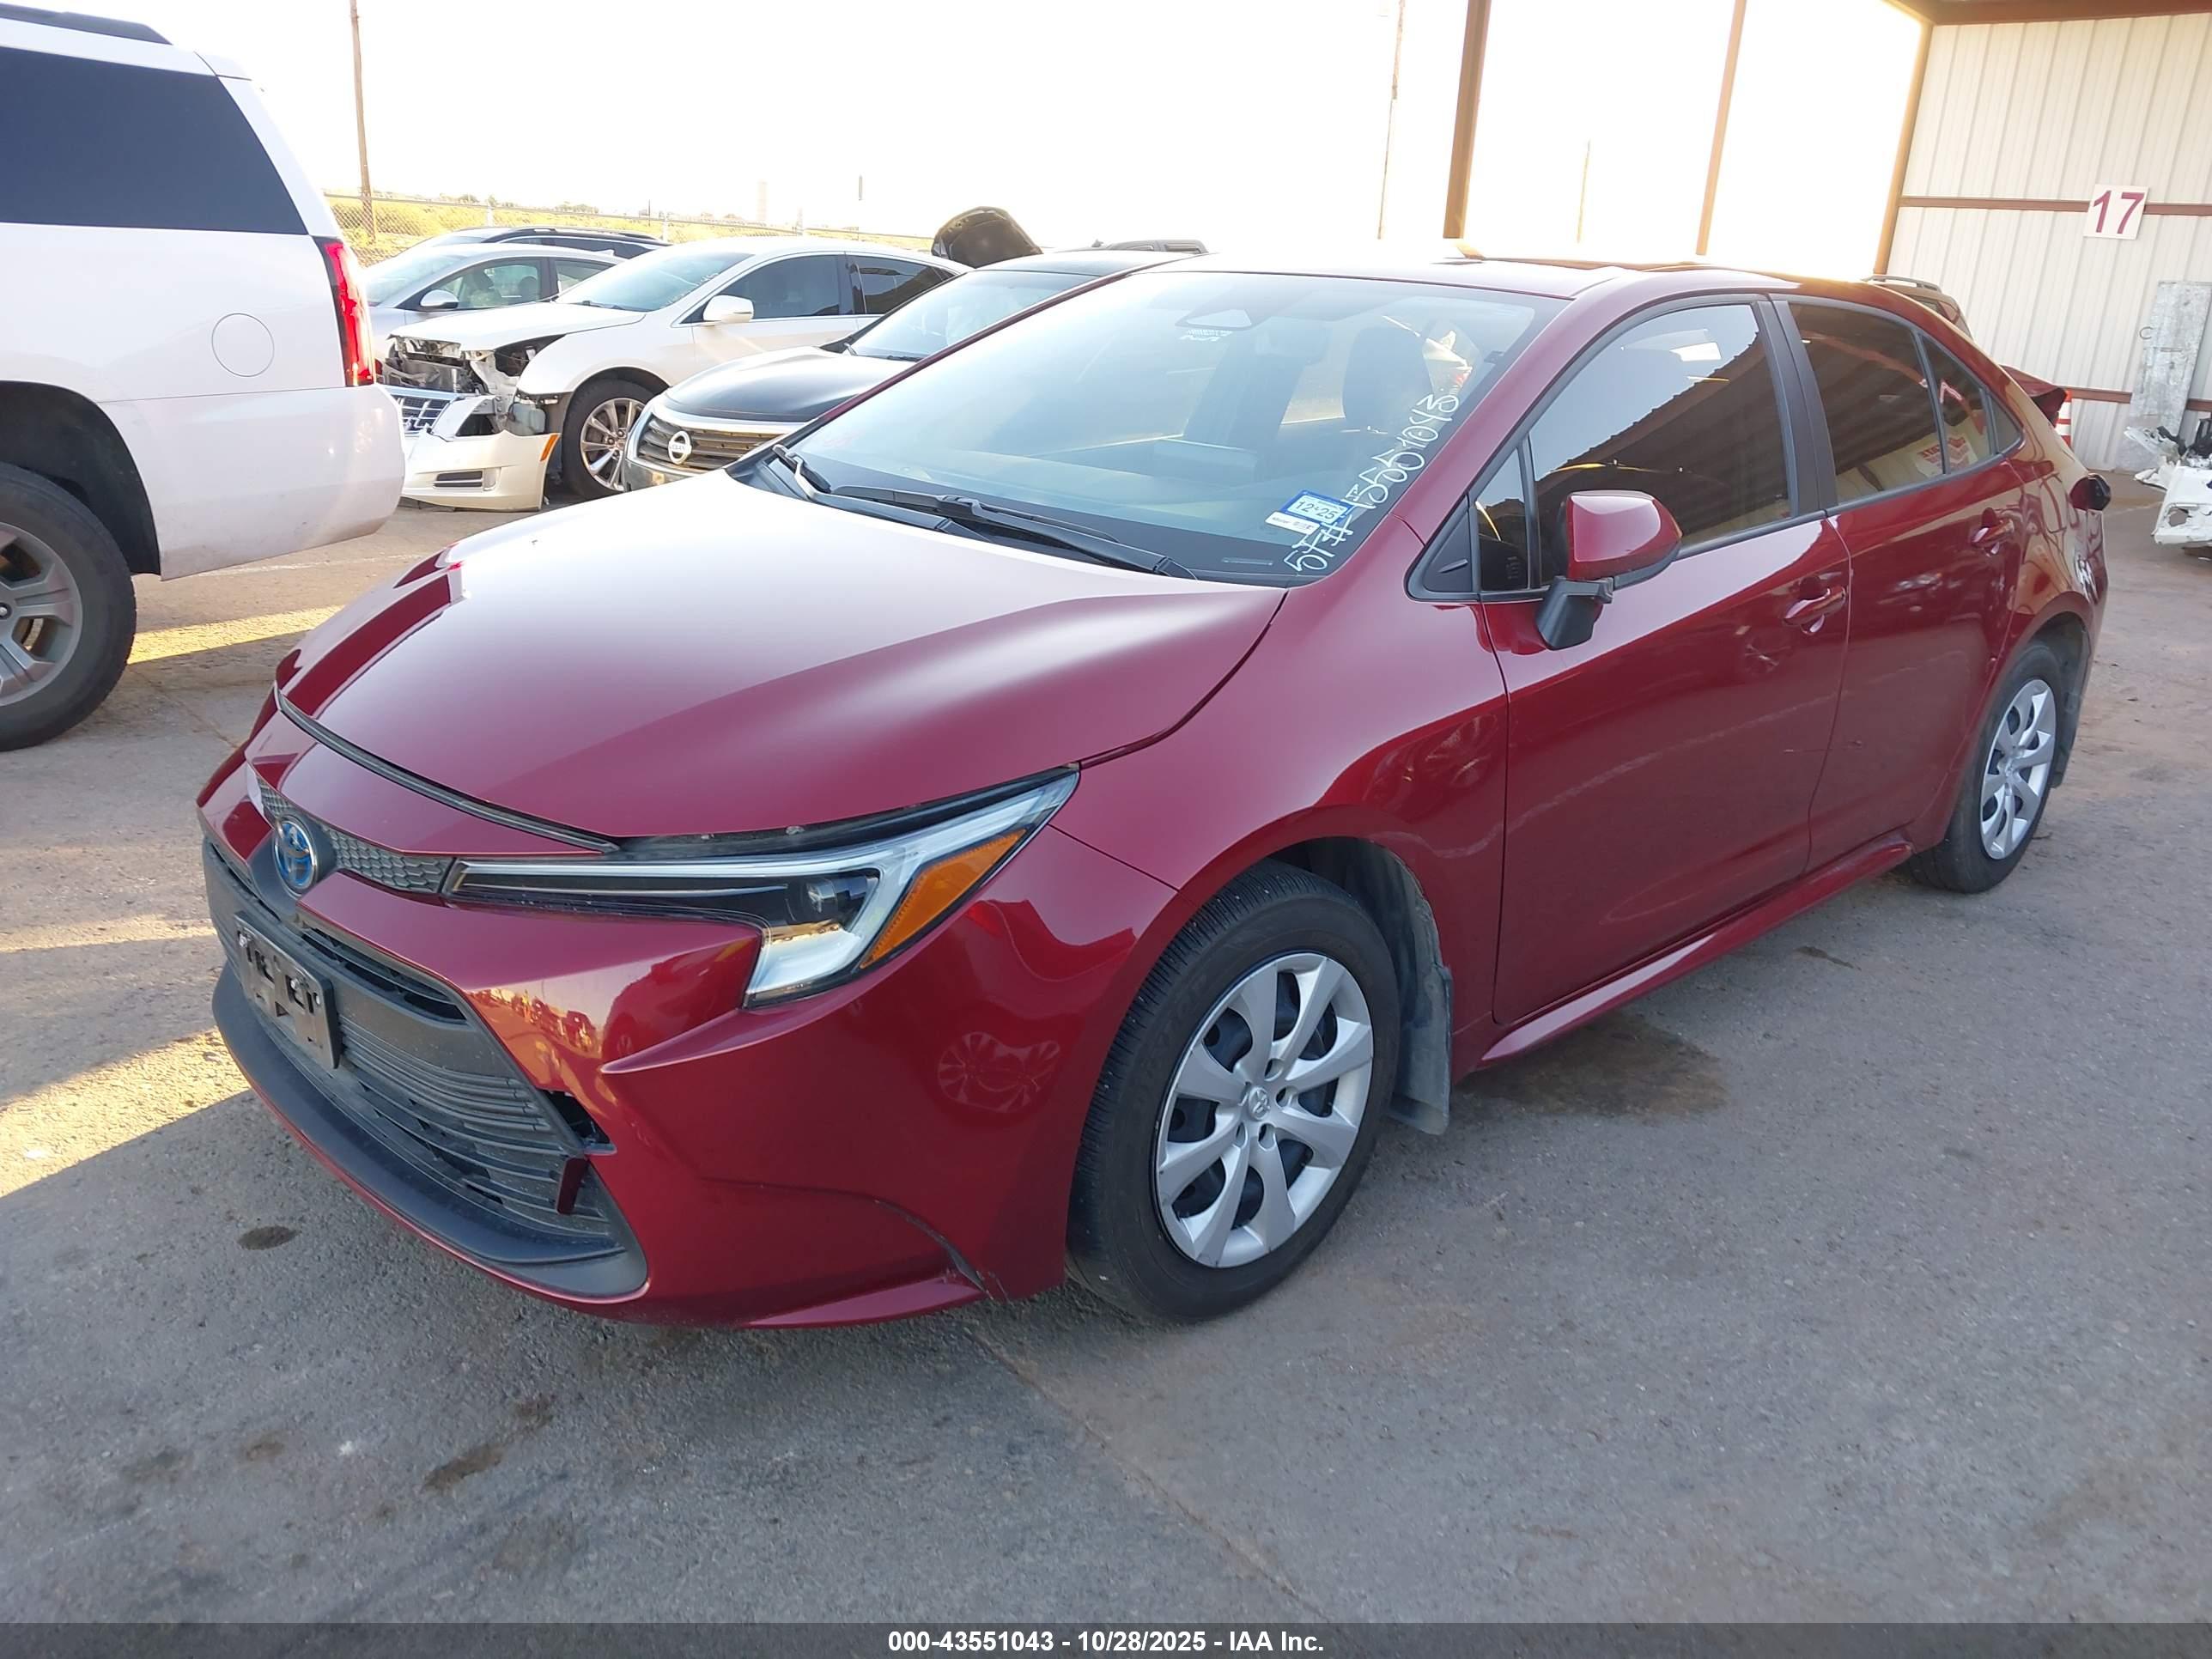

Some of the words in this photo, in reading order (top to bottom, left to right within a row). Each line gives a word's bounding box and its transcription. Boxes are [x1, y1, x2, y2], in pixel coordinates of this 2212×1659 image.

[2093, 189, 2146, 234] 17
[1296, 501, 1314, 513] 12
[1316, 507, 1339, 520] 25
